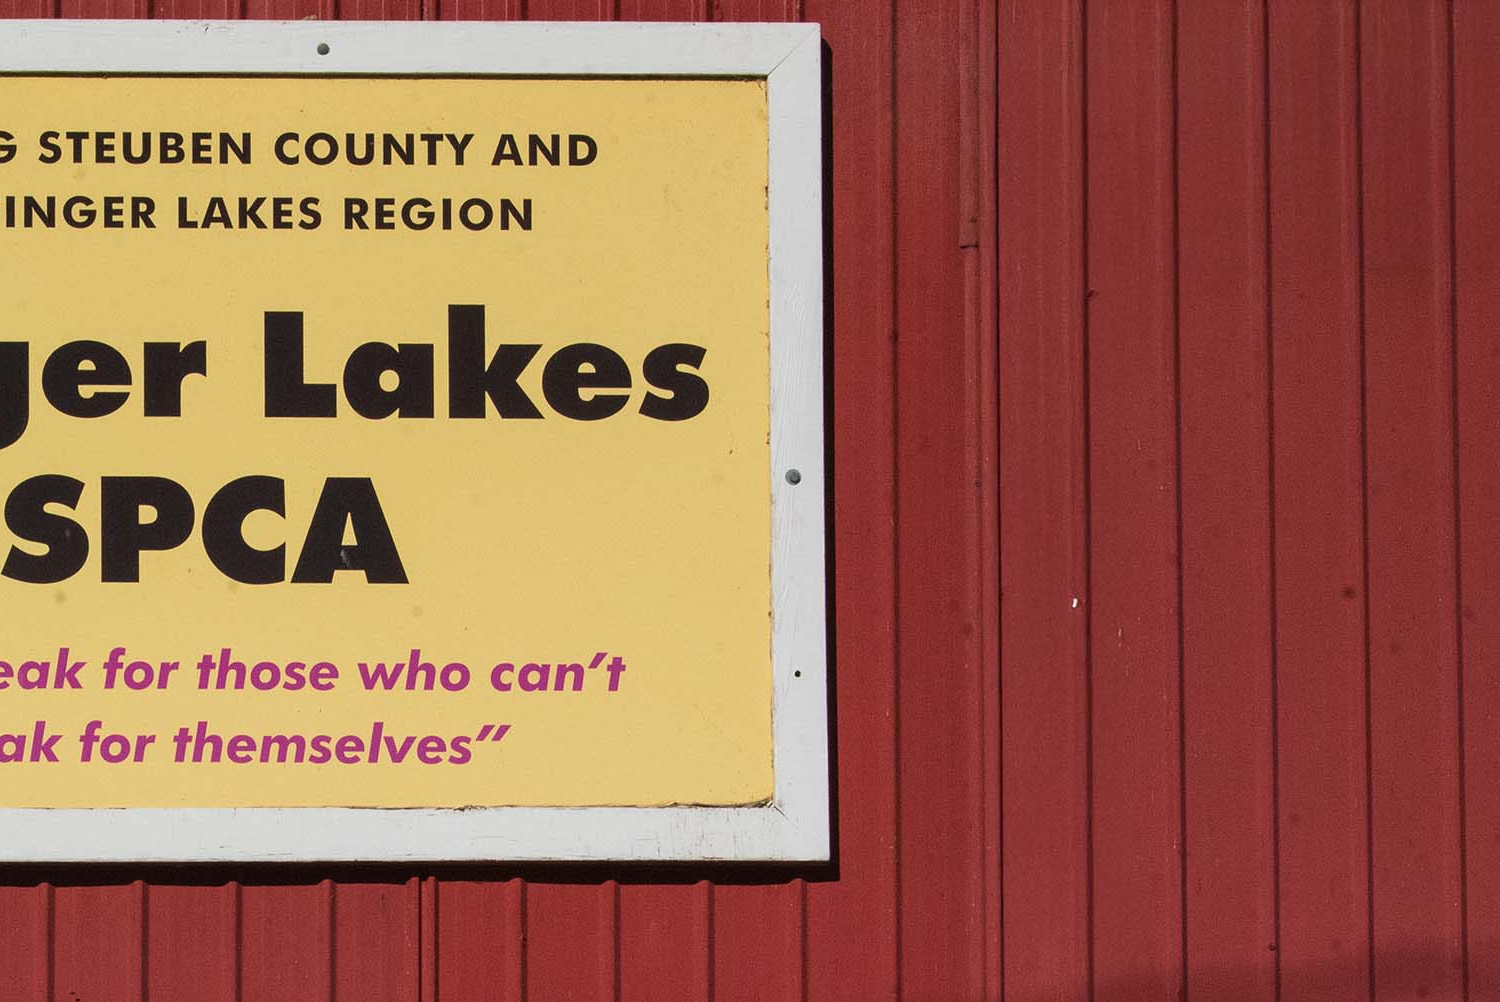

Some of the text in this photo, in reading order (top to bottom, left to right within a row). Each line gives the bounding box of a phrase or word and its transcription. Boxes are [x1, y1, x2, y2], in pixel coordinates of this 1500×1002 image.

[39, 131, 251, 164] STEUBEN
[275, 133, 474, 165] COUNTY
[492, 134, 597, 166] AND
[179, 197, 321, 229] LAKES
[345, 198, 531, 231] REGION
[265, 305, 709, 421] Lakes
[1, 474, 409, 584] SPCA
[103, 648, 179, 689] for
[197, 649, 338, 690] those
[358, 650, 470, 691] who
[491, 653, 625, 691] can't
[80, 721, 155, 763] for
[174, 722, 510, 764] themselves"
